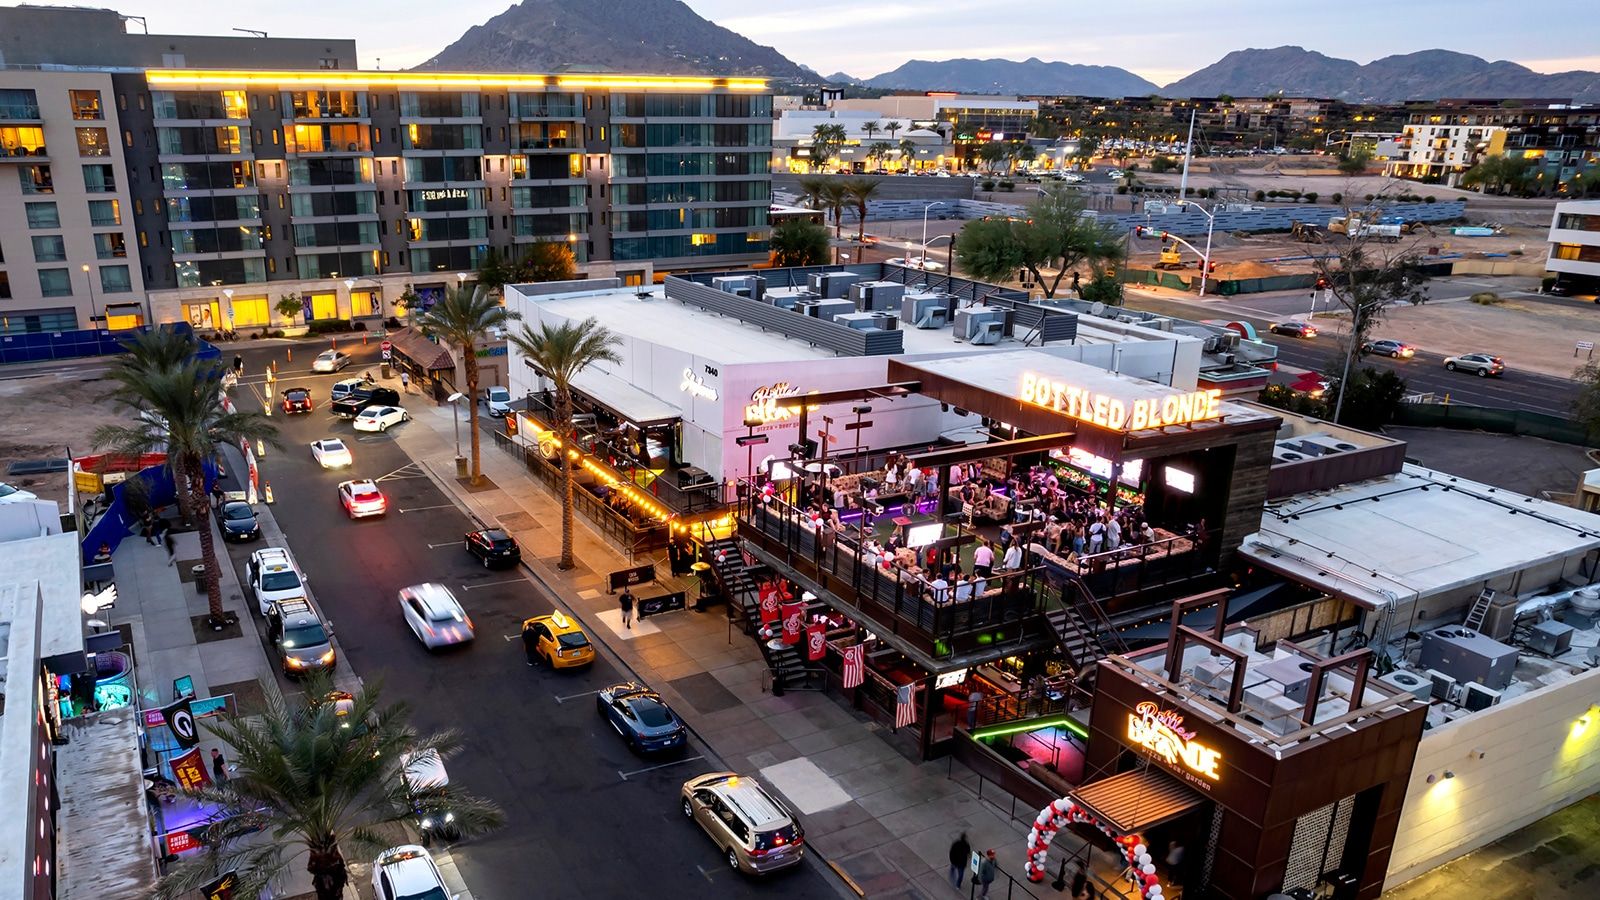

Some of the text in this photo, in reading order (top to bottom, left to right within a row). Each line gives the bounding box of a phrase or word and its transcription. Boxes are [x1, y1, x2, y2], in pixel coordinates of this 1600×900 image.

[704, 364, 718, 377] 7340
[1021, 371, 1222, 430] BOTTLED BLONDE
[1136, 701, 1198, 741] Bottled
[1185, 772, 1212, 791] garden
[170, 834, 189, 843] ENTER
